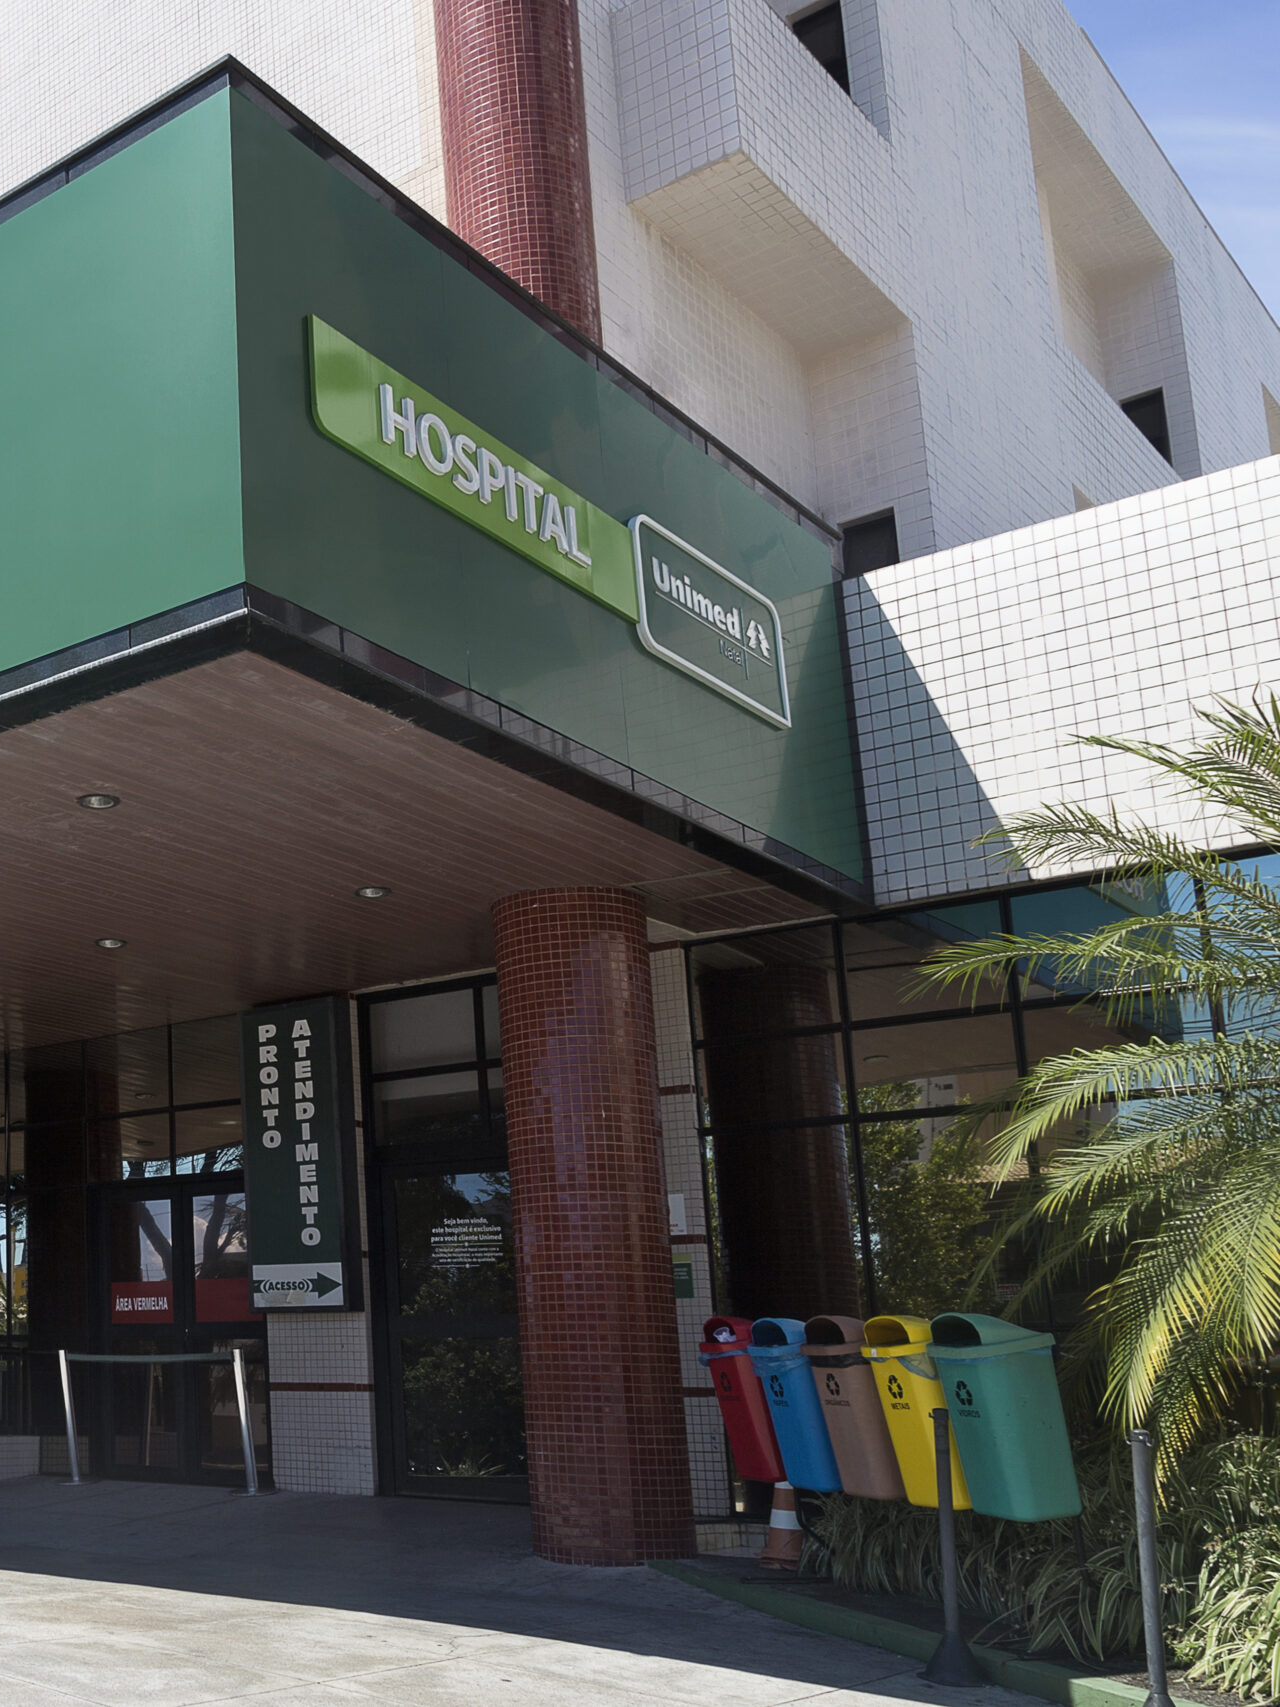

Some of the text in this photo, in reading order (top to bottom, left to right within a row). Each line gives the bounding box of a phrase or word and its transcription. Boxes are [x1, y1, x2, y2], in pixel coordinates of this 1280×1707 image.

[378, 382, 593, 569] HOSPITAL
[651, 556, 741, 640] Unimed
[258, 1023, 282, 1149] PRONTO
[291, 1018, 322, 1247] ATENDIMENTO
[444, 1218, 456, 1226] Seja
[445, 1226, 468, 1234] hospital
[115, 1295, 169, 1312] ÁREA VERMELHA
[891, 1402, 910, 1410] METAIS
